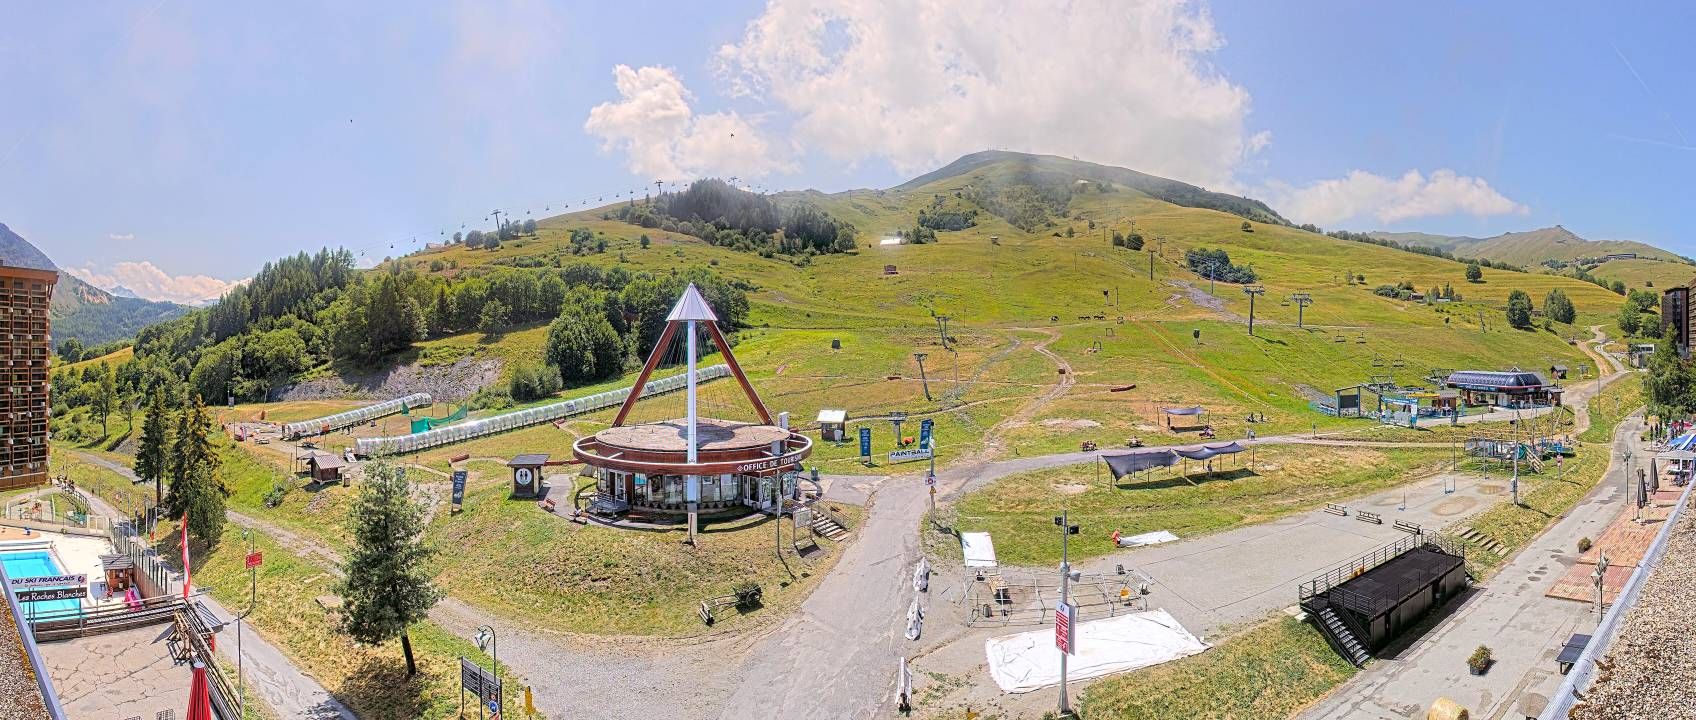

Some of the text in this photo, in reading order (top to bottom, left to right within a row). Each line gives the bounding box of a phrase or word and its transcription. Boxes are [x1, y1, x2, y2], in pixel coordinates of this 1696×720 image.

[743, 462, 767, 471] OFFICE
[17, 589, 87, 601] Les Roches Blanches
